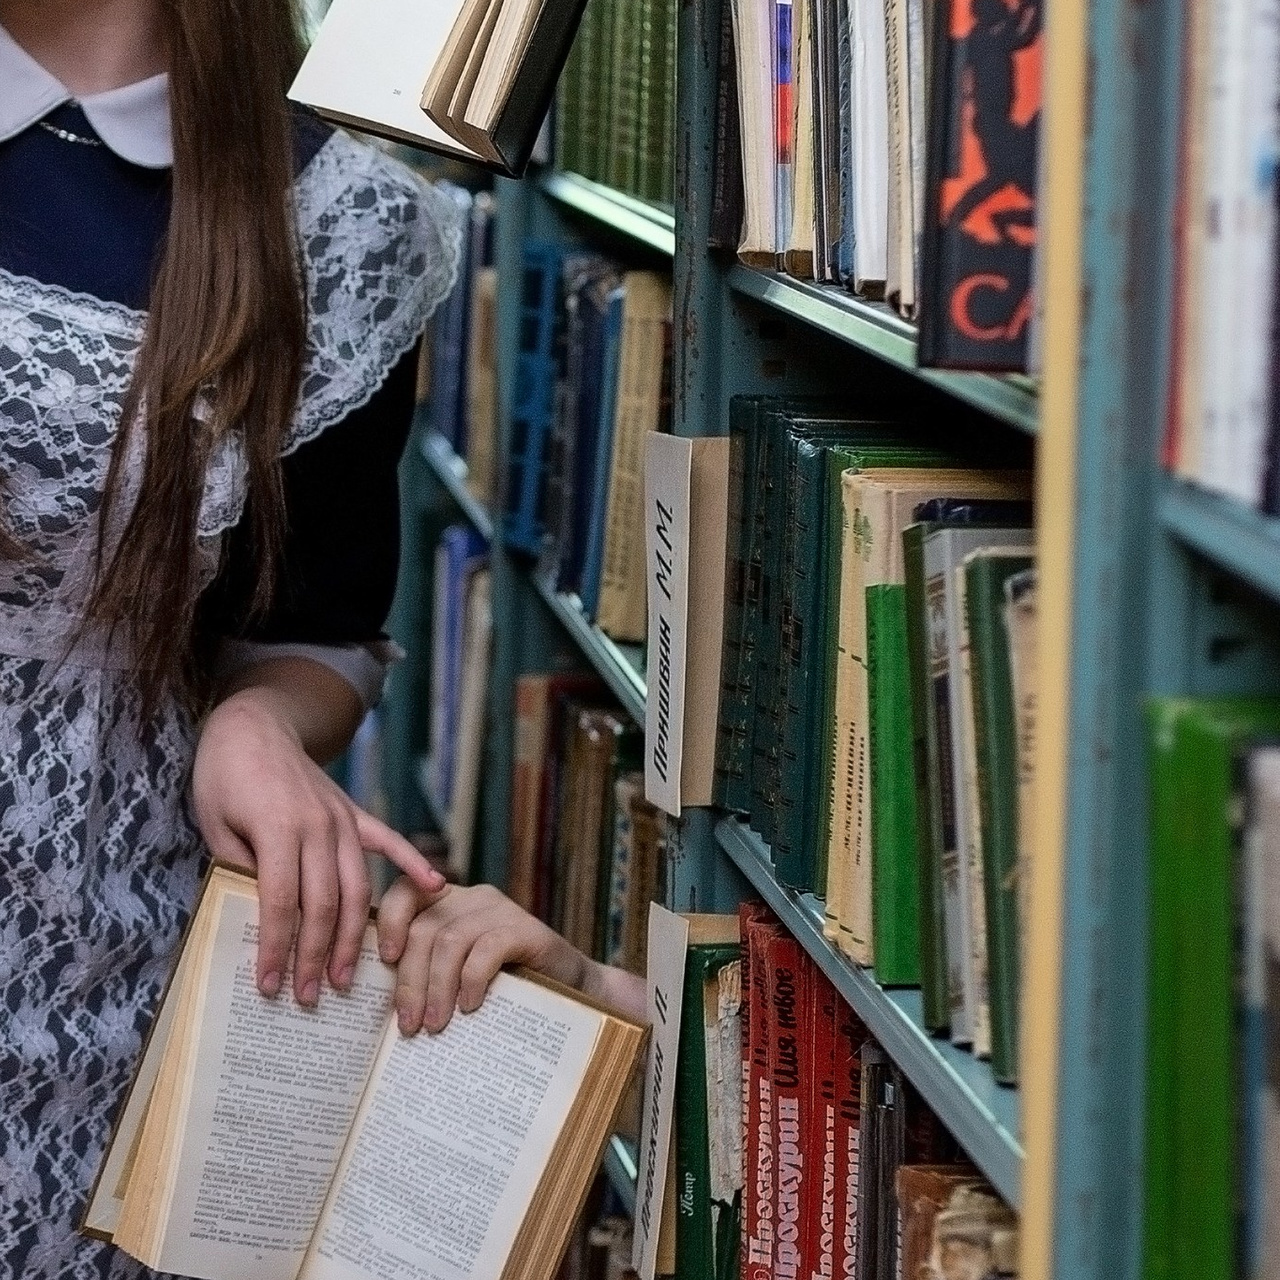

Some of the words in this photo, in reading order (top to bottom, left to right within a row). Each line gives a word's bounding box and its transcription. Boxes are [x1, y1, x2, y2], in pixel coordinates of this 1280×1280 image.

[653, 613, 671, 782] Пришвин
[641, 1038, 666, 1242] Проскурин
[679, 1171, 696, 1216] Петр
[750, 1076, 774, 1267] Проскурин
